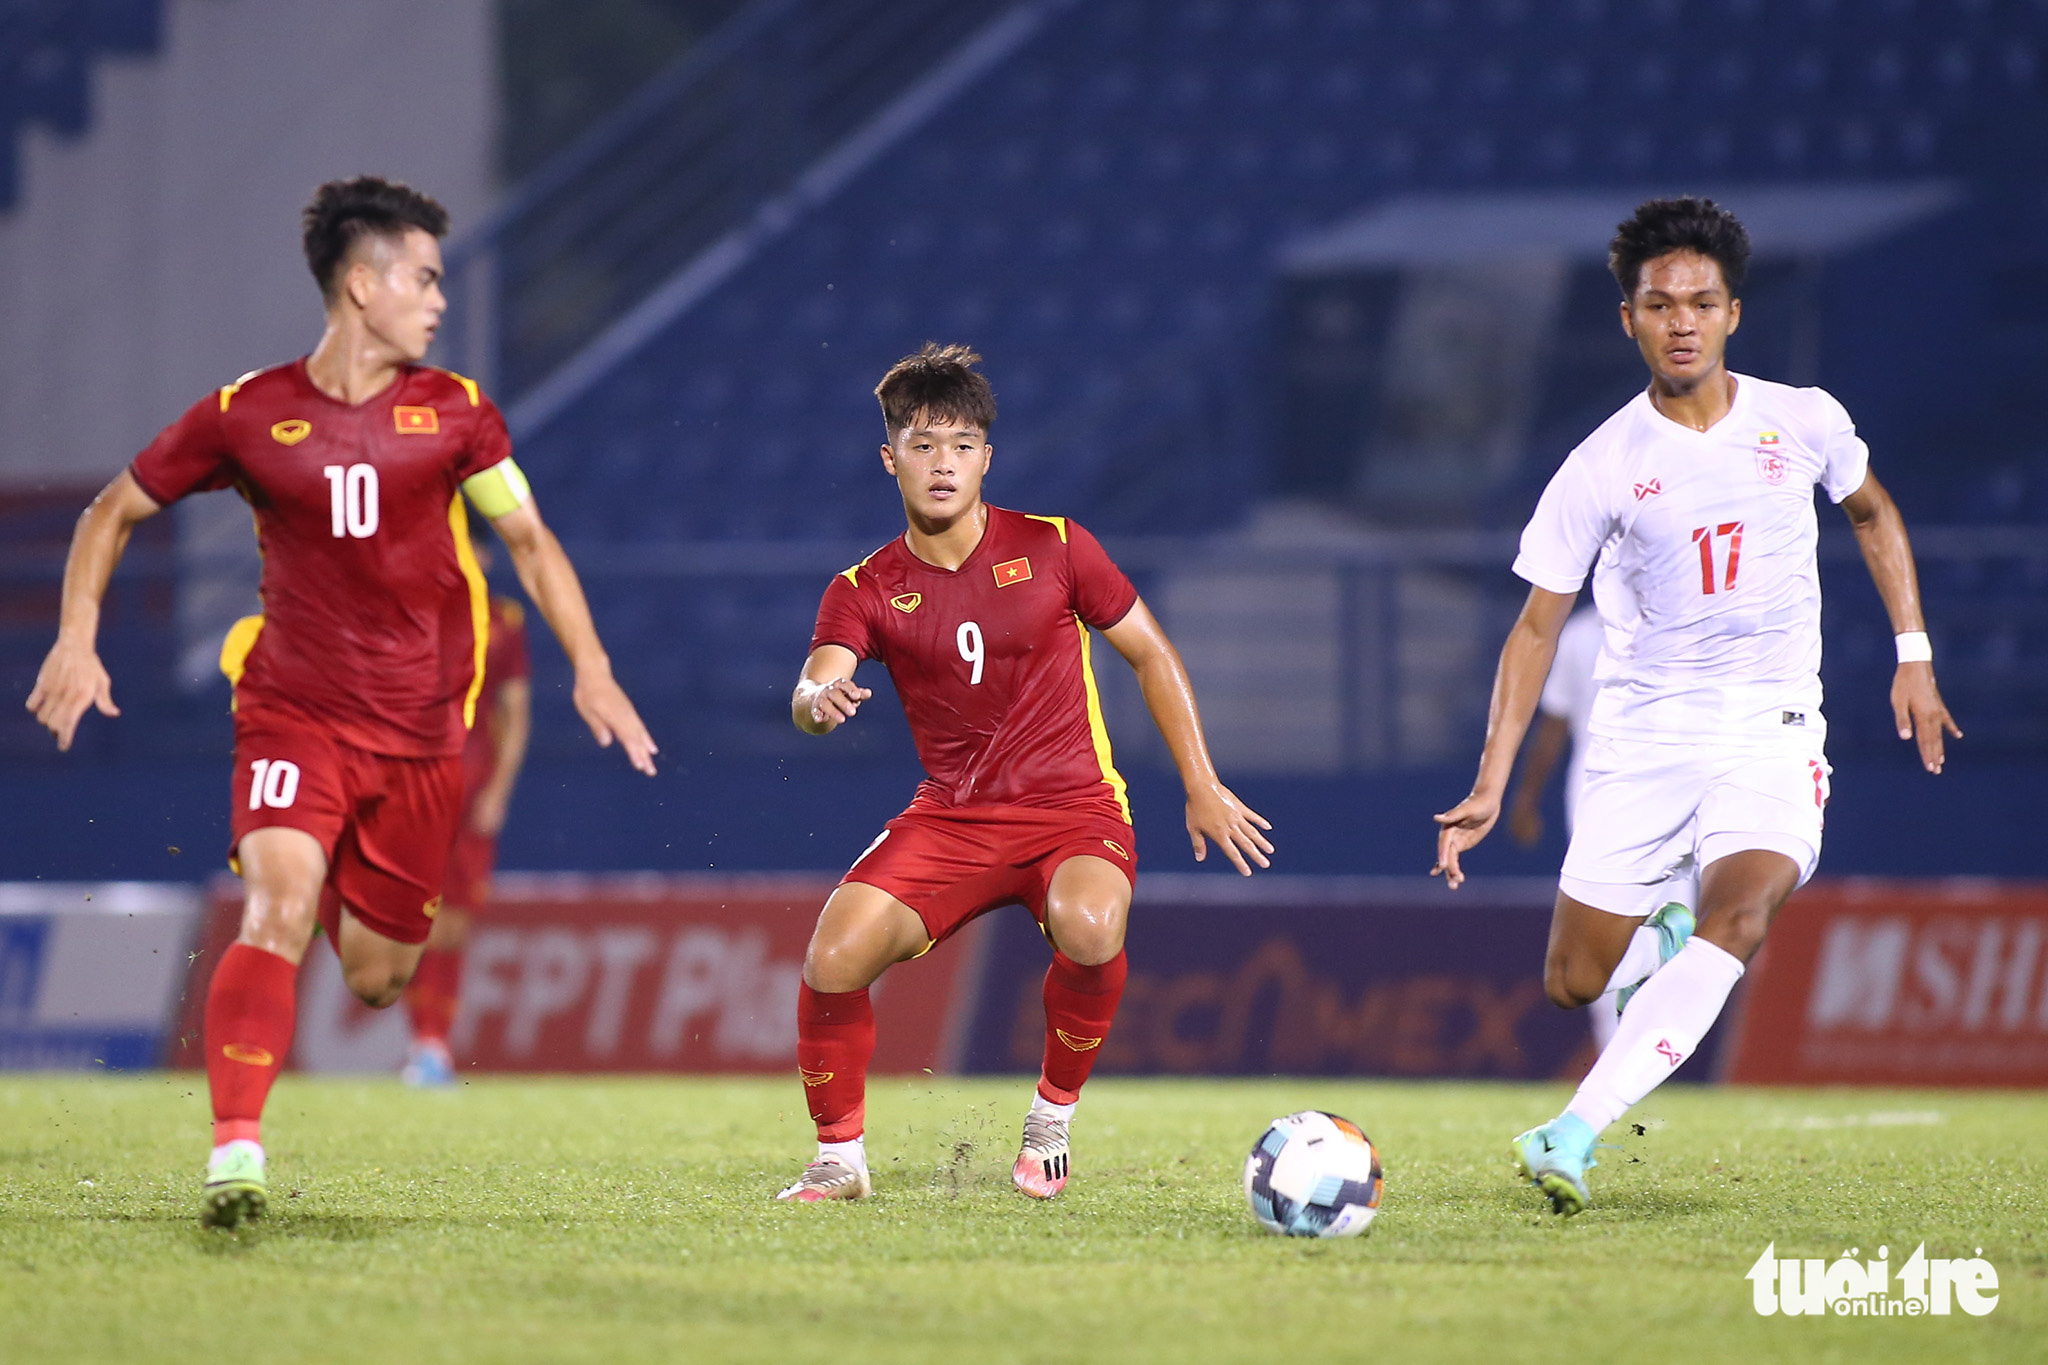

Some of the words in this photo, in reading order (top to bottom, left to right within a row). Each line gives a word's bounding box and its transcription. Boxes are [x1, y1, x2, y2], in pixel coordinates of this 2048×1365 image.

[324, 463, 379, 538] 10
[1692, 521, 1744, 595] 17
[956, 621, 985, 685] 9
[249, 758, 300, 810] 10
[456, 925, 654, 1060] FPT
[646, 925, 800, 1060] Pla
